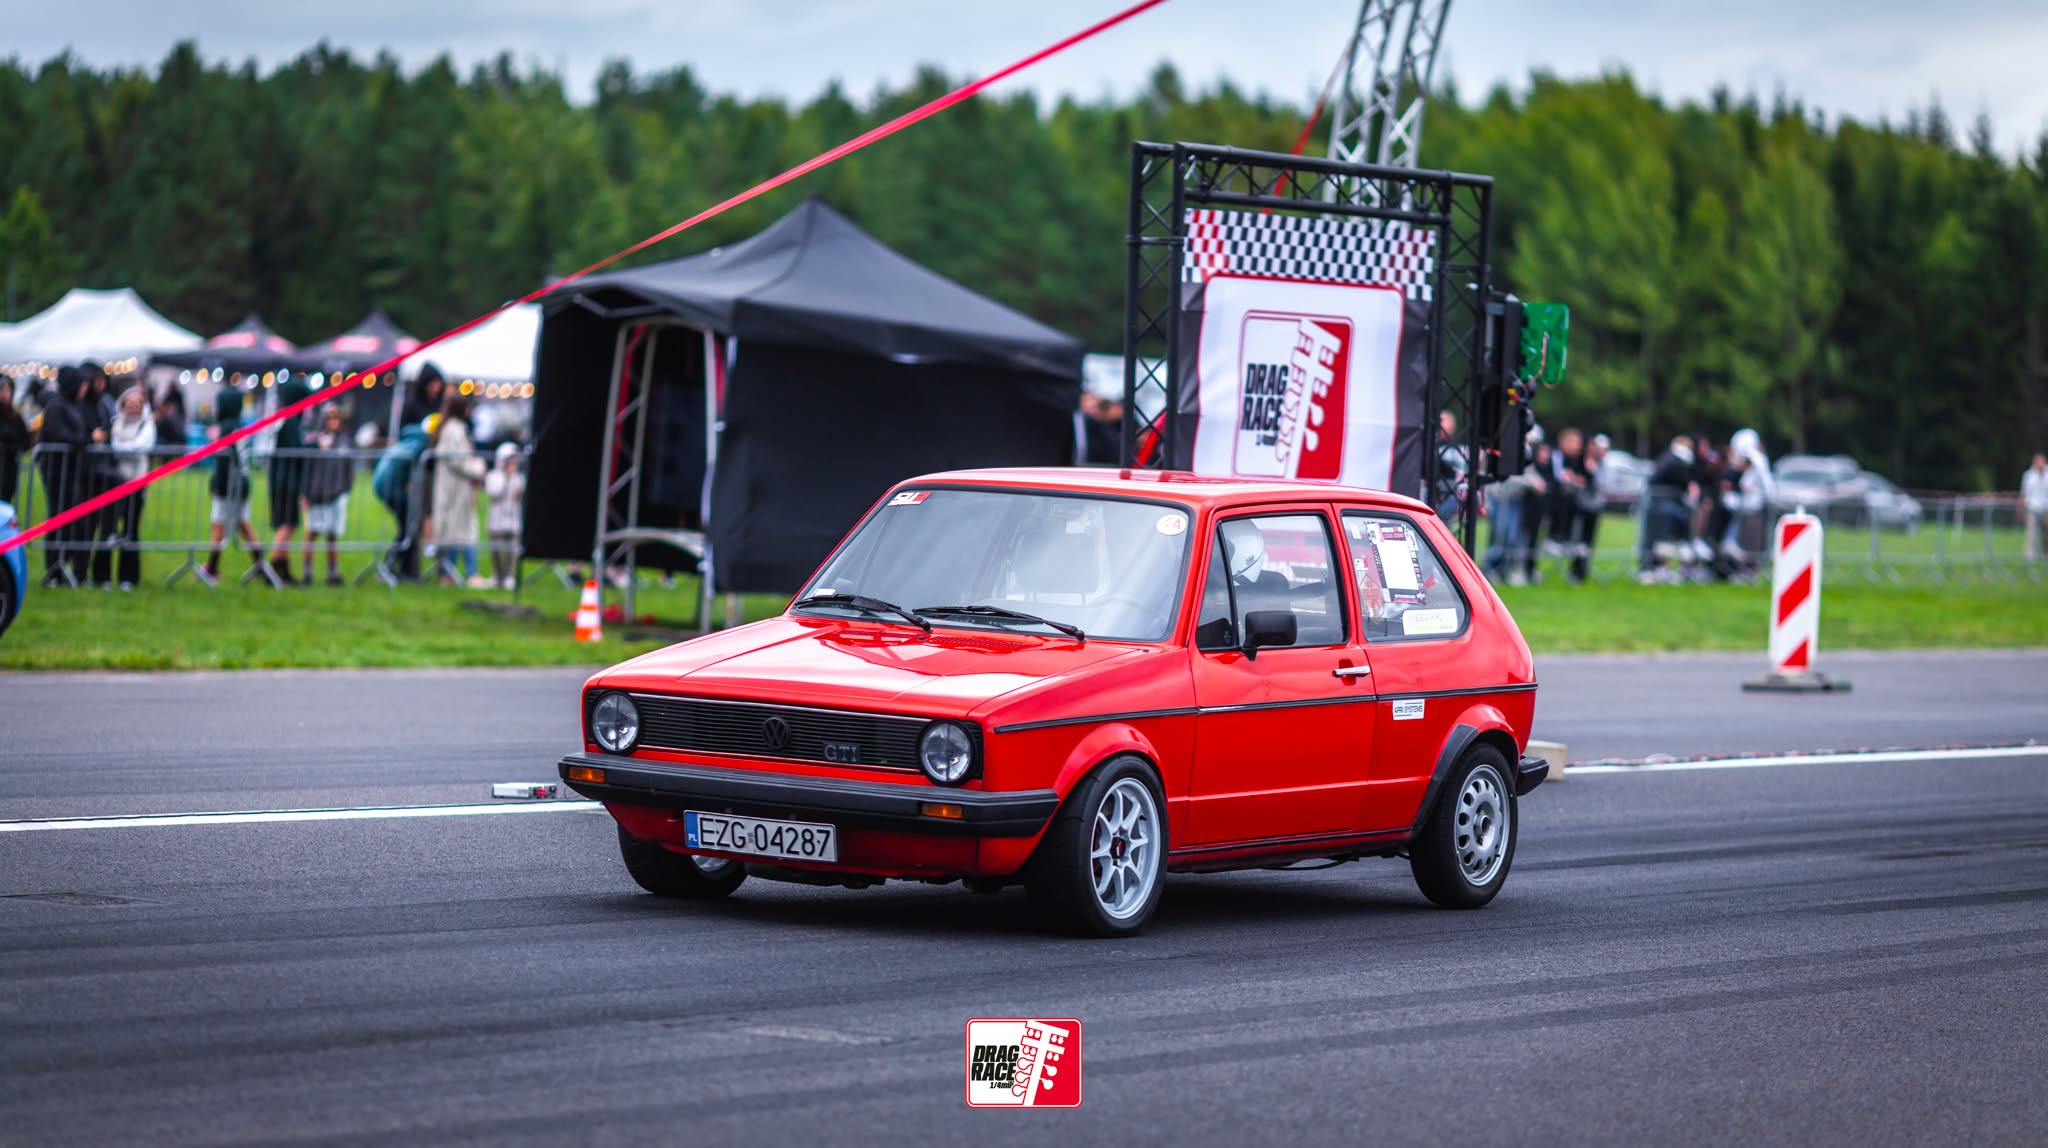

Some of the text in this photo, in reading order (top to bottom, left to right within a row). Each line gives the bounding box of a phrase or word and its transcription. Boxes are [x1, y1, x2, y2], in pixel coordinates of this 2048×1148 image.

[1245, 363, 1289, 395] DRAG
[1241, 396, 1284, 431] RACE
[825, 745, 857, 762] GTI
[688, 833, 697, 842] PL
[700, 818, 830, 857] EZG 04287
